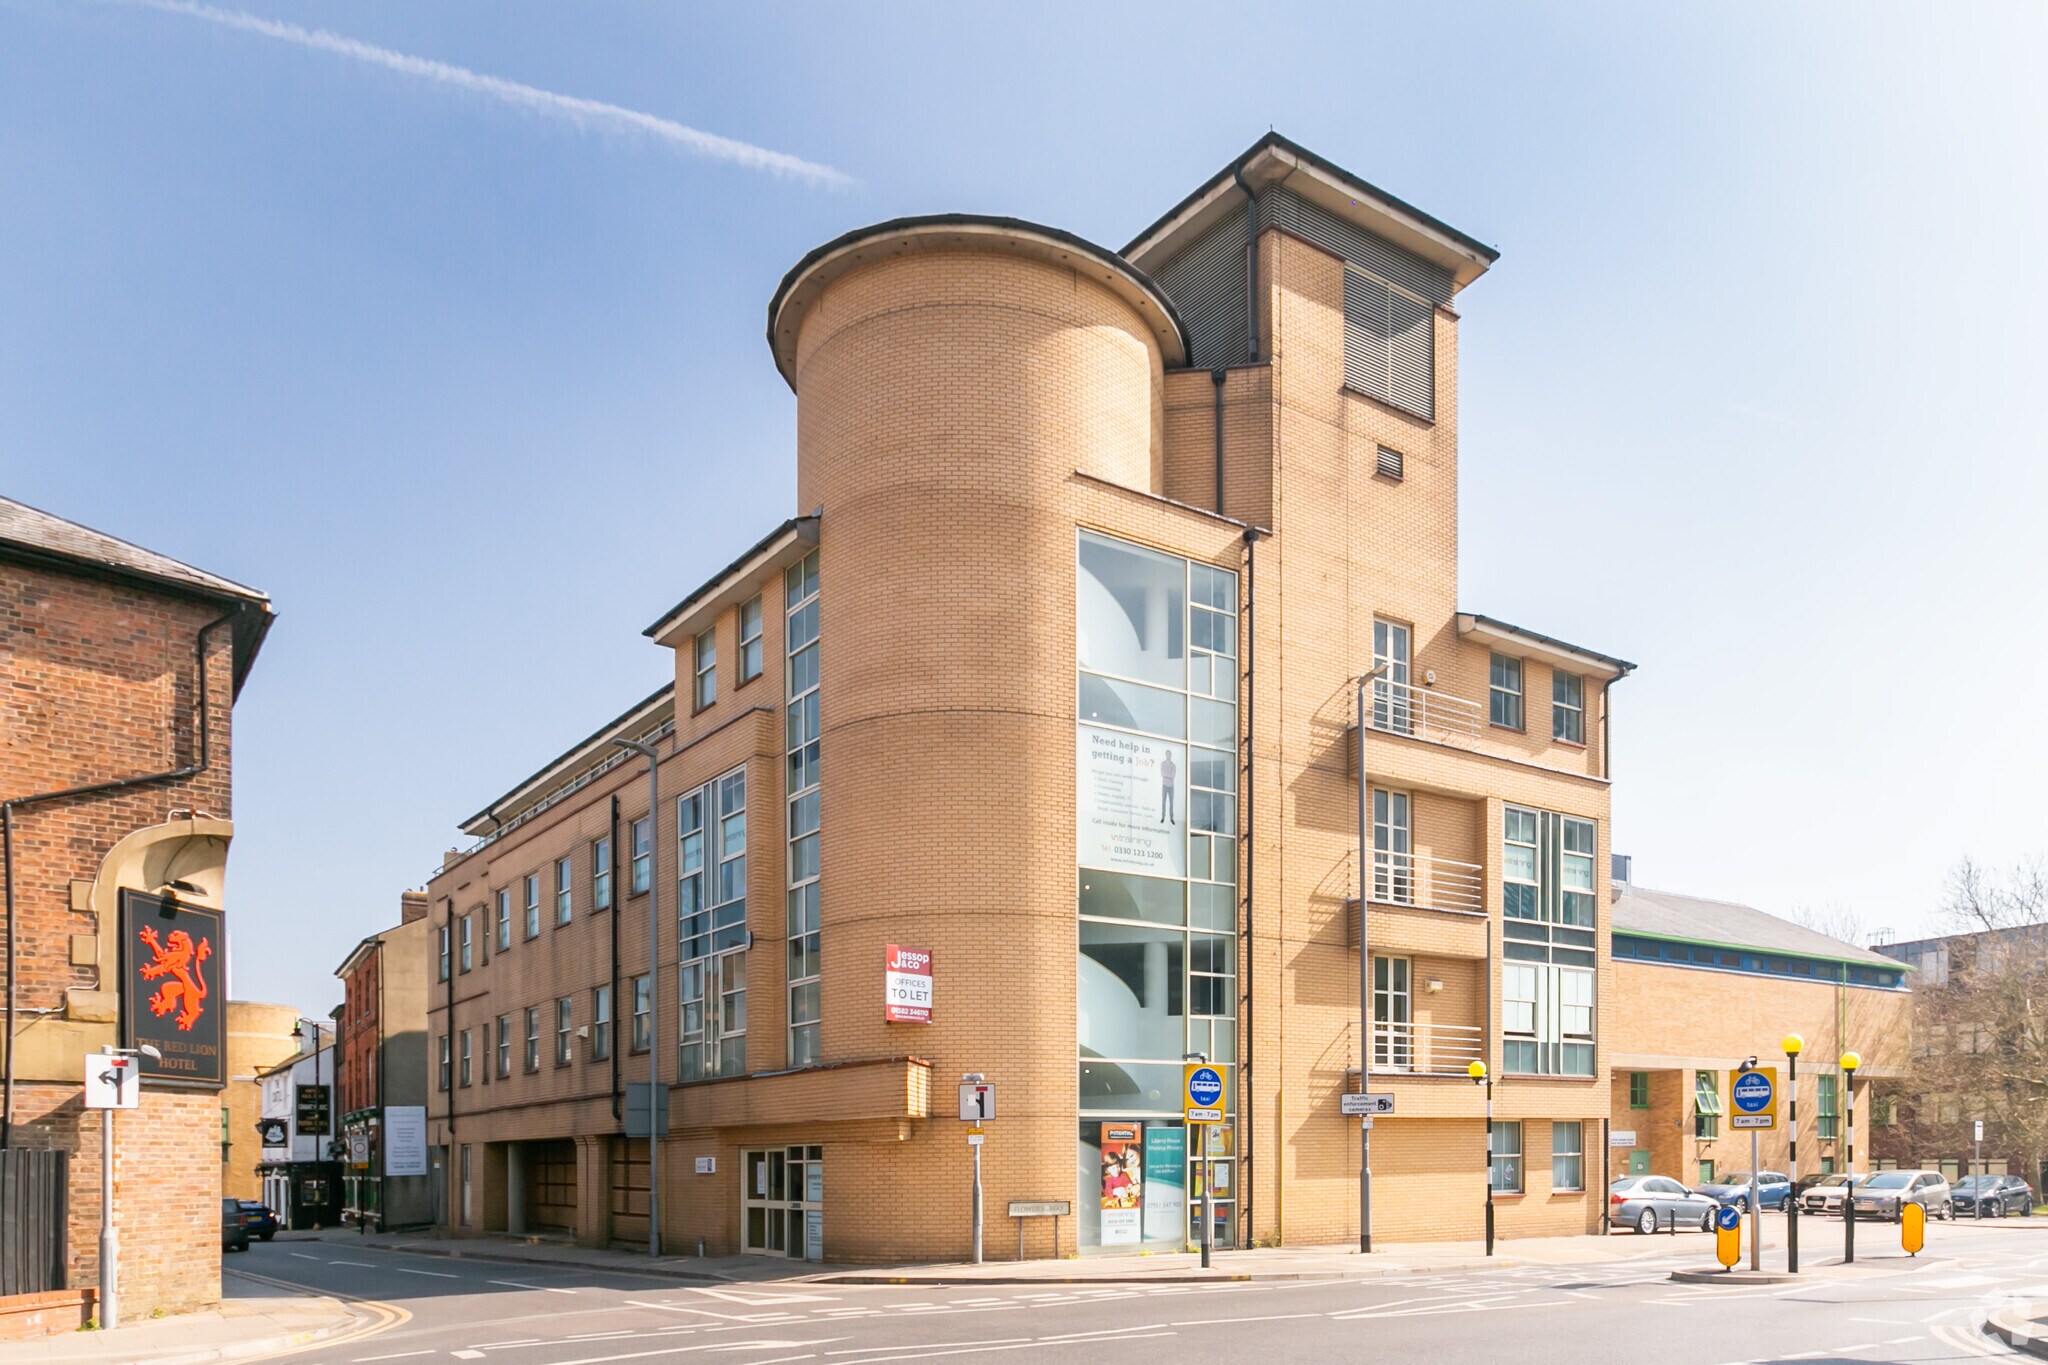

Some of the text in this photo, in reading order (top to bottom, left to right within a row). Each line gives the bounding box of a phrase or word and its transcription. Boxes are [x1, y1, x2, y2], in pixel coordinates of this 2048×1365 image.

[1092, 735, 1151, 753] Need help in
[1092, 751, 1125, 764] getting
[1103, 819, 1117, 827] inside
[1141, 825, 1170, 834] information
[1114, 846, 1131, 854] 0330
[1133, 849, 1145, 857] 123
[1147, 851, 1163, 859] 1200
[890, 951, 929, 968] Jessop
[895, 978, 926, 988] OFFICES
[892, 988, 928, 1001] TO LET
[164, 1041, 186, 1053] RED
[190, 1043, 217, 1056] LION
[159, 1058, 198, 1070] HOTEL
